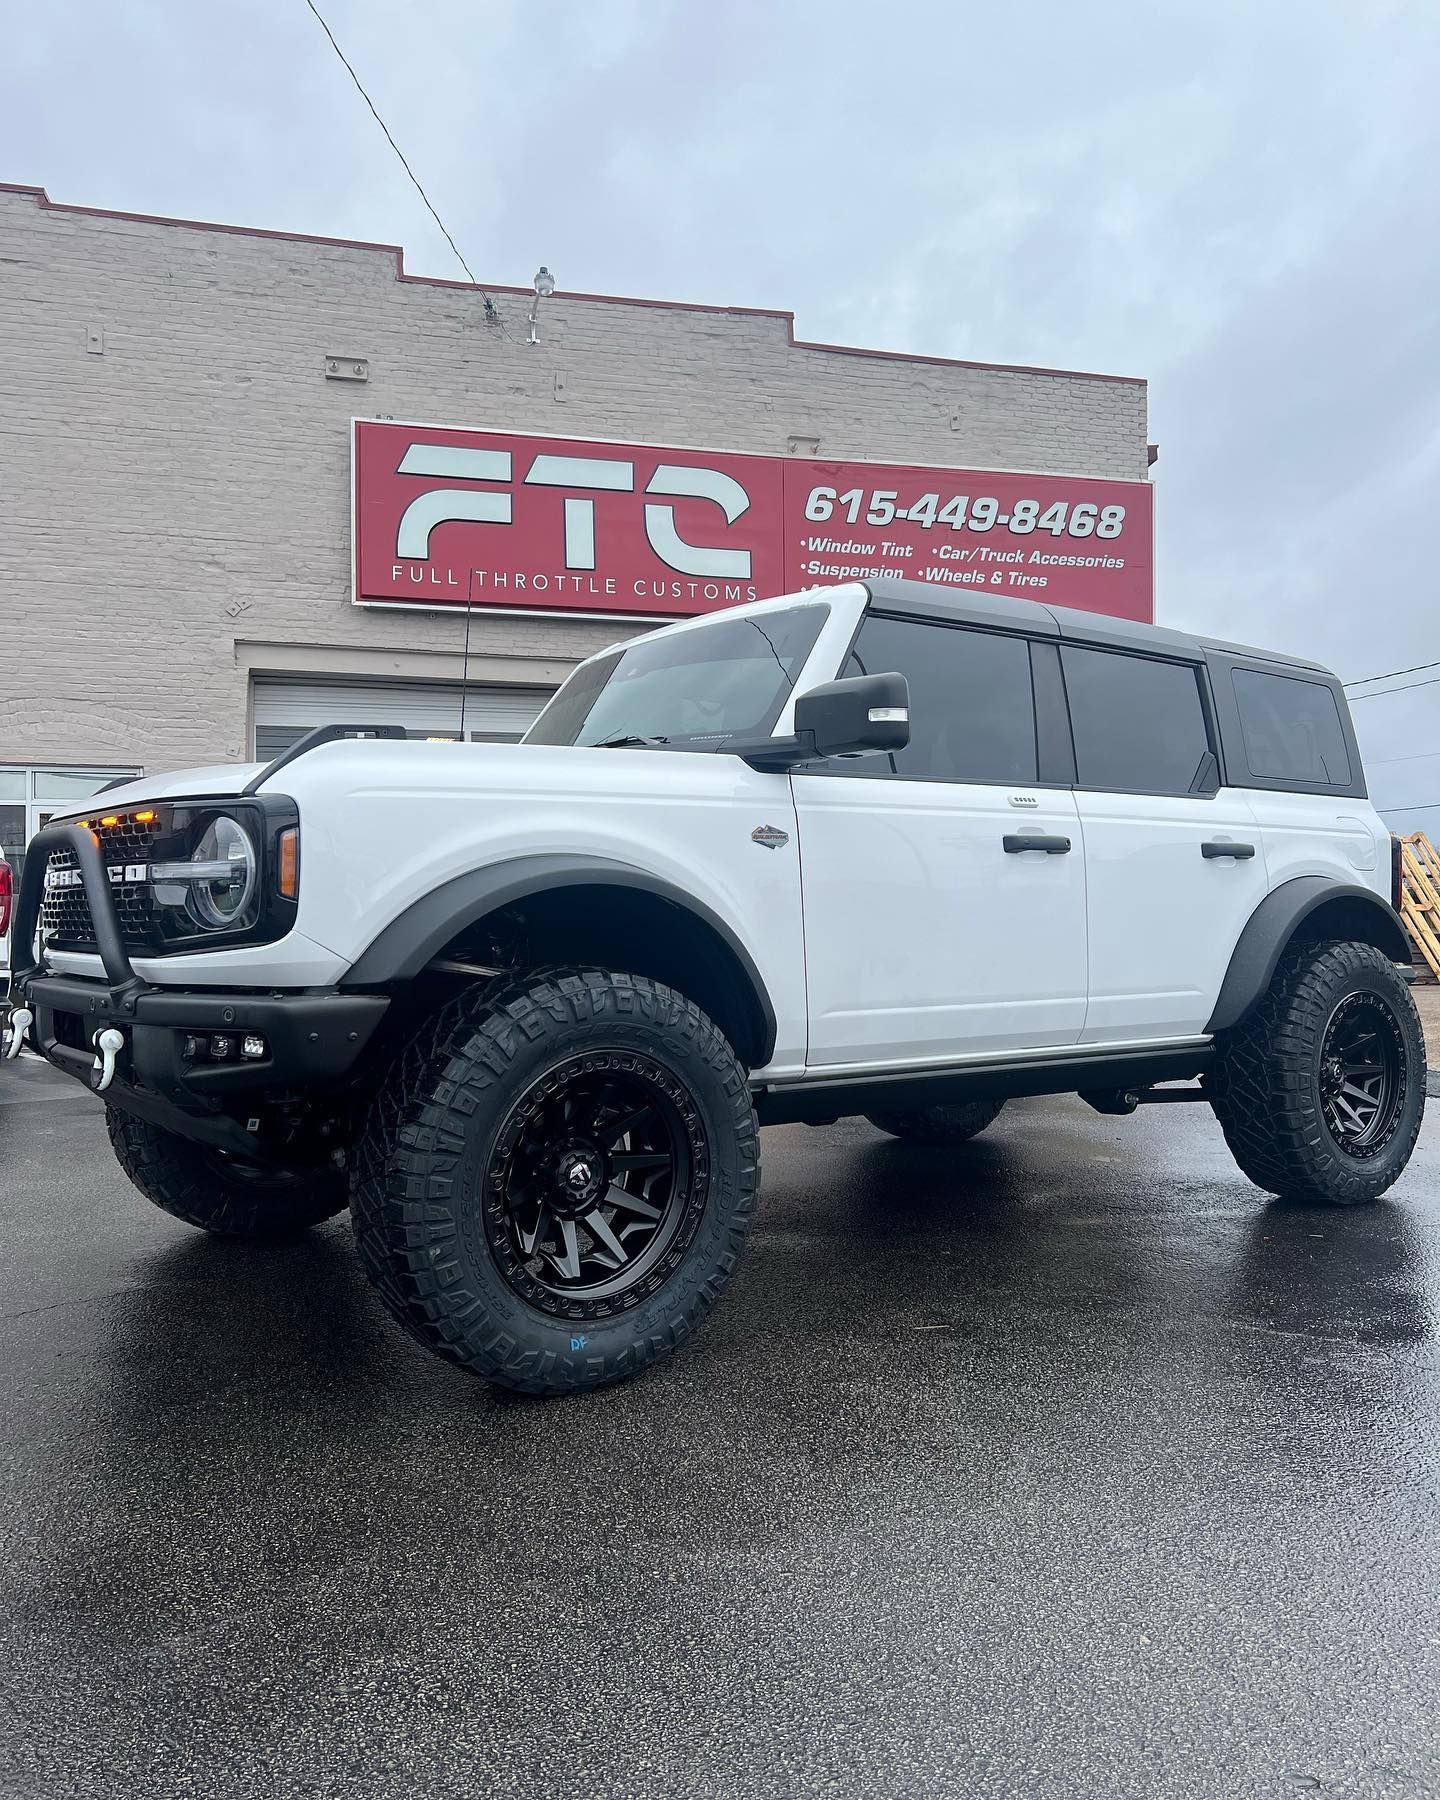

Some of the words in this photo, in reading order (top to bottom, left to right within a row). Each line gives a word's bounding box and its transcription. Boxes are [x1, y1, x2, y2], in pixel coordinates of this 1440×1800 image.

[396, 442, 752, 580] FTC
[803, 486, 1127, 540] 615-449-8468
[808, 536, 876, 555] Window
[881, 541, 914, 557] Tint
[938, 545, 1025, 563] Car/Truck
[1028, 550, 1126, 569] Accessories
[807, 560, 904, 580] Suspension
[925, 567, 985, 584] Wheels
[990, 571, 1003, 585] &
[1008, 571, 1048, 587] Tires
[392, 565, 459, 586] FULL
[475, 570, 617, 595] THROTTLE
[633, 581, 758, 601] CUSTOMS
